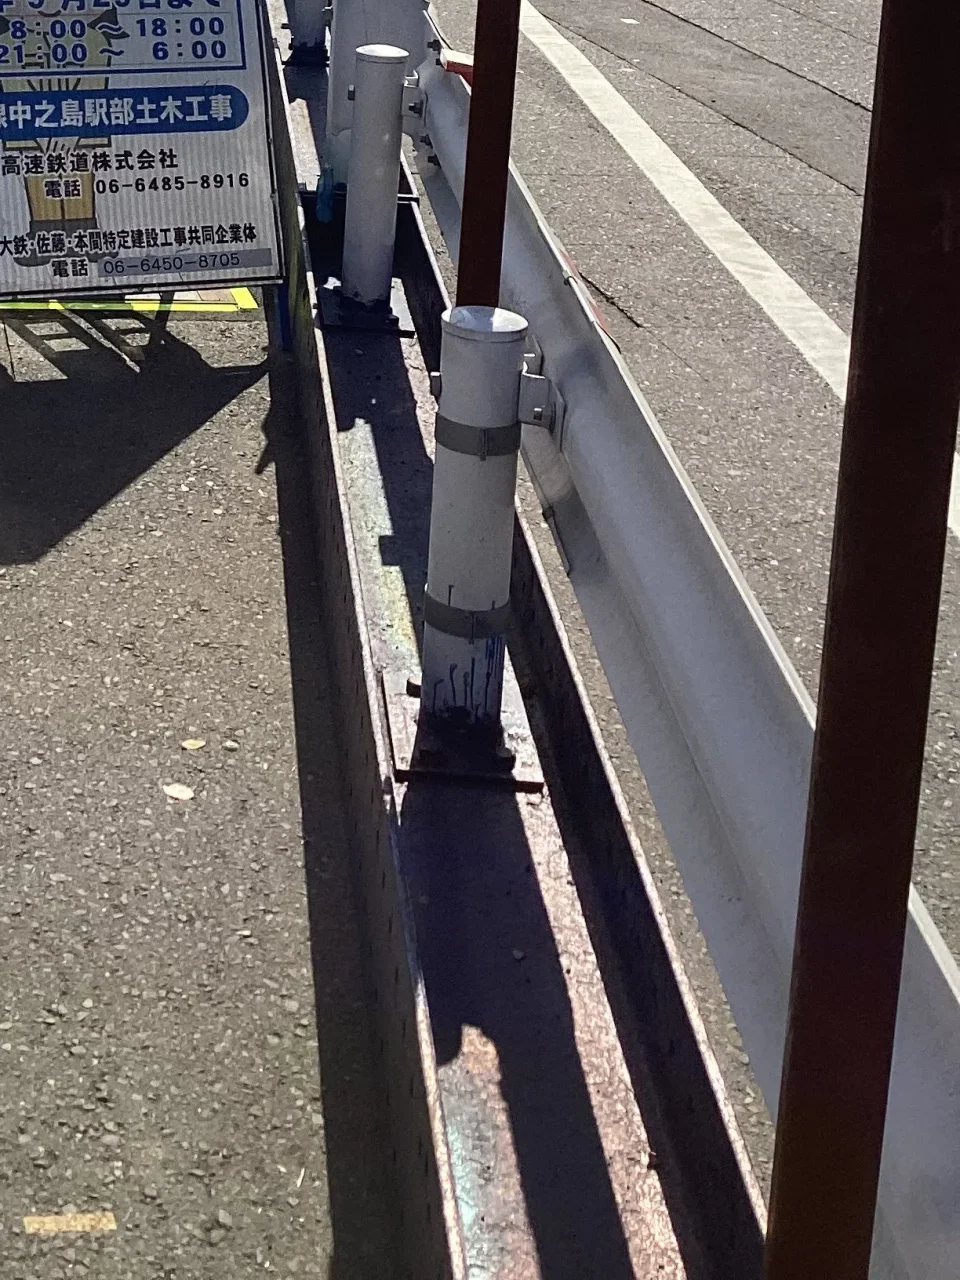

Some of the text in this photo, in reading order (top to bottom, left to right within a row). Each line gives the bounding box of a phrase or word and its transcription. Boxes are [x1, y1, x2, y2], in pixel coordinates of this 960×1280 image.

[44, 173, 249, 198] 電話 06-6485-8916
[52, 252, 240, 277] 電話 06-6450-8705
